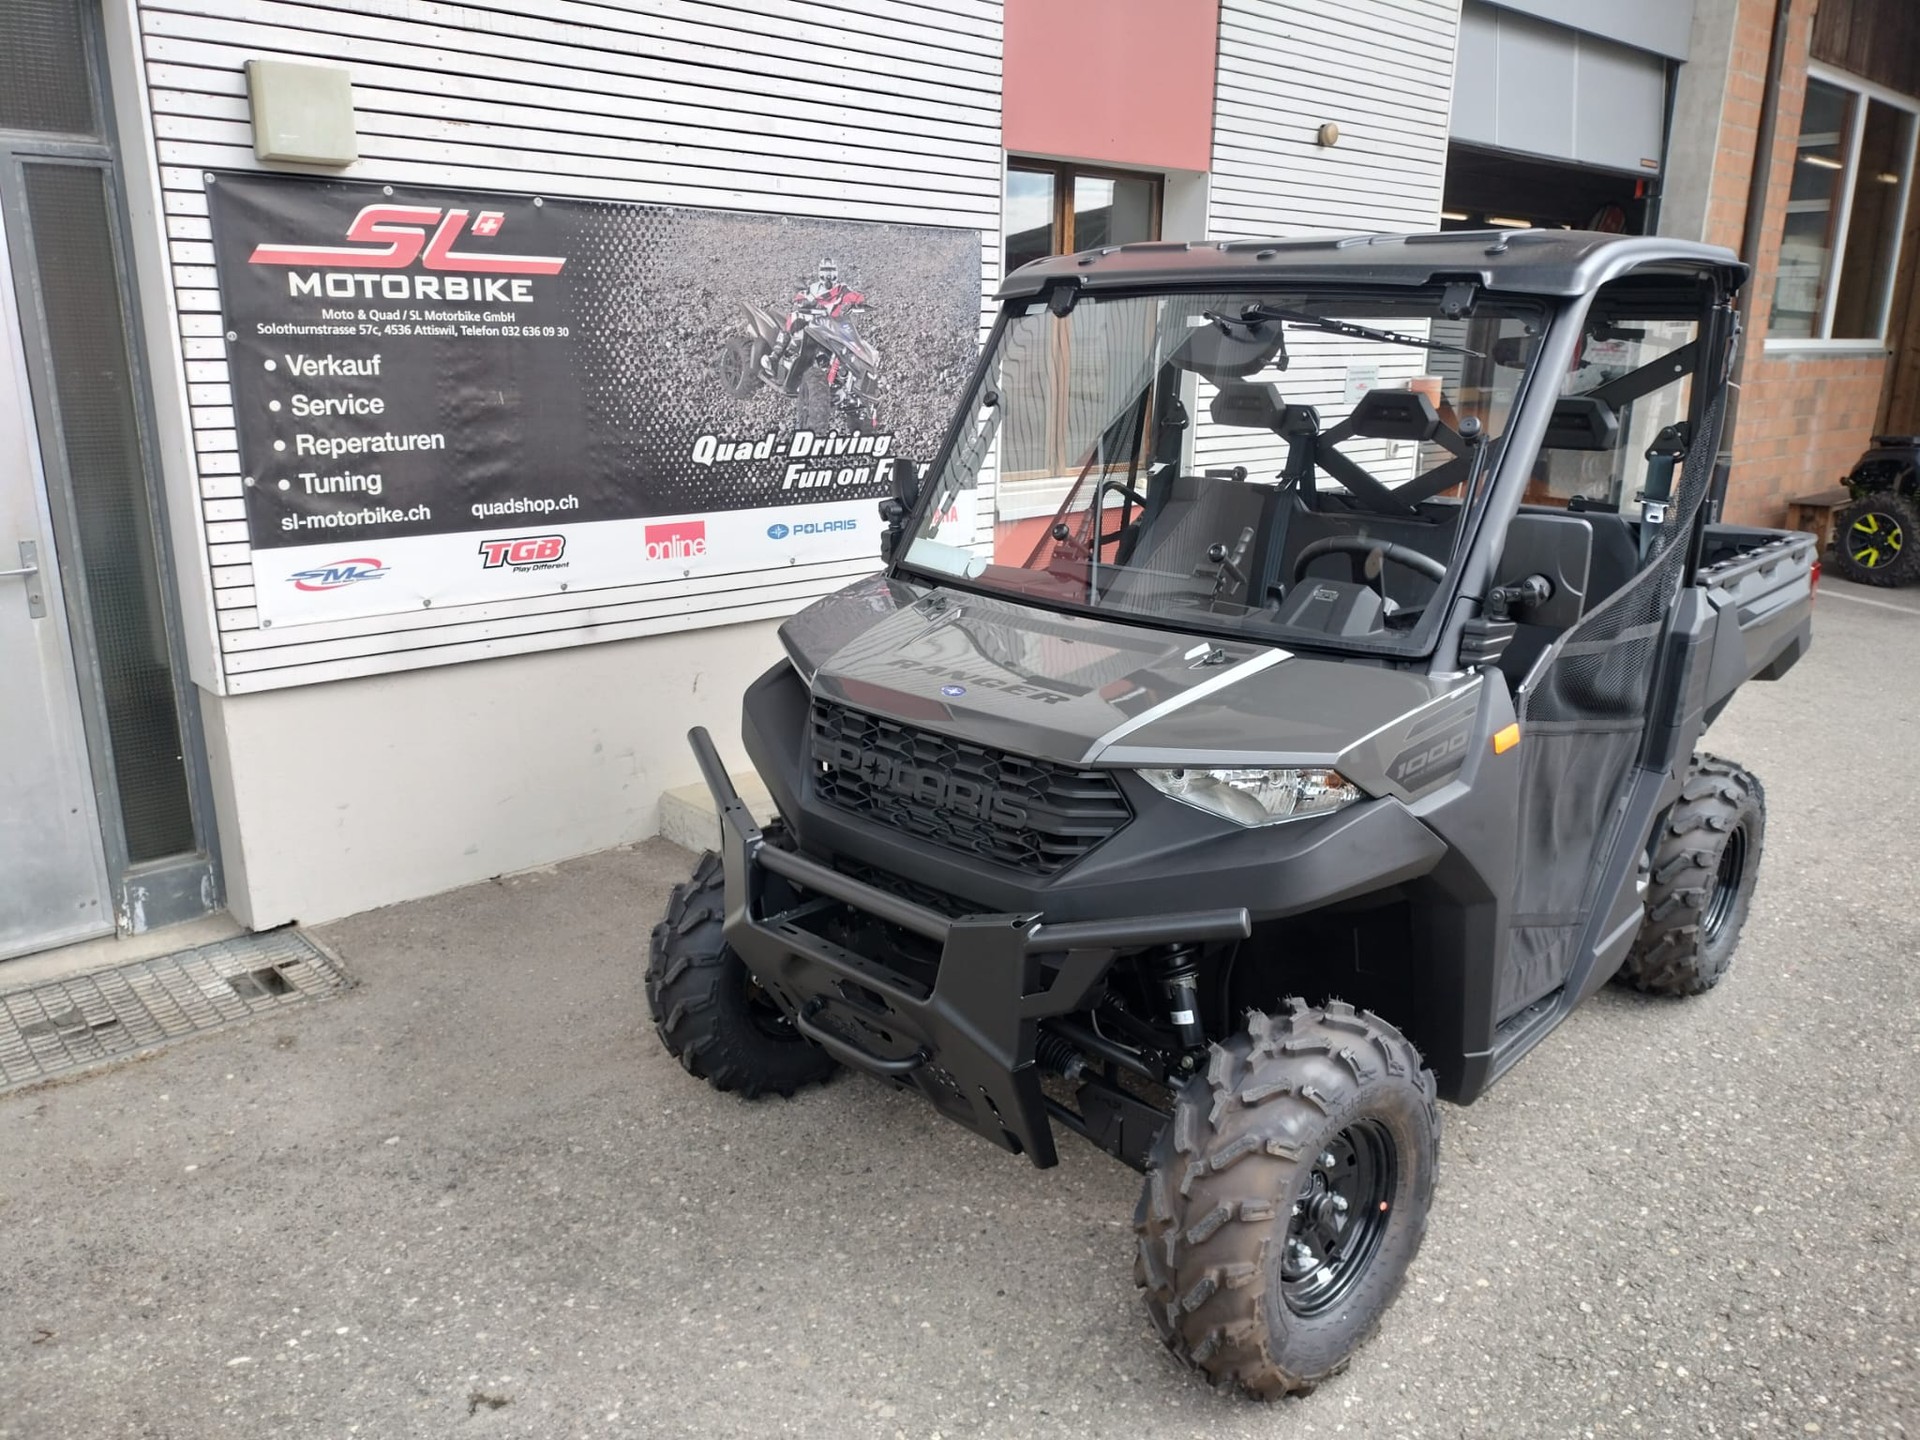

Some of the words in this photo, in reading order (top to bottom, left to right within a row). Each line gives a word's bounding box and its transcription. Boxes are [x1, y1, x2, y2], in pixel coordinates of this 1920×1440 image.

[288, 272, 534, 302] MOTORBIKE
[321, 309, 354, 320] Moto
[358, 309, 367, 320] &
[369, 309, 401, 322] Quad
[402, 310, 408, 320] /
[409, 310, 422, 321] SL
[424, 310, 481, 322] Motorbike
[483, 312, 516, 322] GmbH
[257, 323, 357, 335] Solothurnstrasse
[359, 324, 382, 336] 57c,
[384, 325, 411, 335] 4536
[414, 324, 459, 337] Attiswil,
[460, 325, 500, 336] Telefon
[501, 326, 521, 336] 032
[522, 326, 541, 337] 636
[543, 327, 556, 337] 09
[557, 327, 570, 337] 30
[284, 354, 382, 376] Verkauf
[291, 393, 385, 418] Service
[296, 431, 446, 459] Reperaturen
[299, 471, 383, 496] Tuning
[781, 463, 833, 490] Fun
[837, 467, 870, 485] on
[873, 458, 931, 483] Fr
[281, 504, 432, 531] sl-motorbike.ch
[471, 495, 580, 519] quadshop.ch
[793, 519, 857, 535] POLARIS
[481, 537, 564, 566] TGB
[646, 533, 706, 561] online
[285, 566, 392, 583] SMC
[532, 561, 570, 571] Different
[886, 659, 1071, 705] RANGER
[1396, 729, 1469, 780] 1000
[833, 740, 1028, 830] POLARIS
